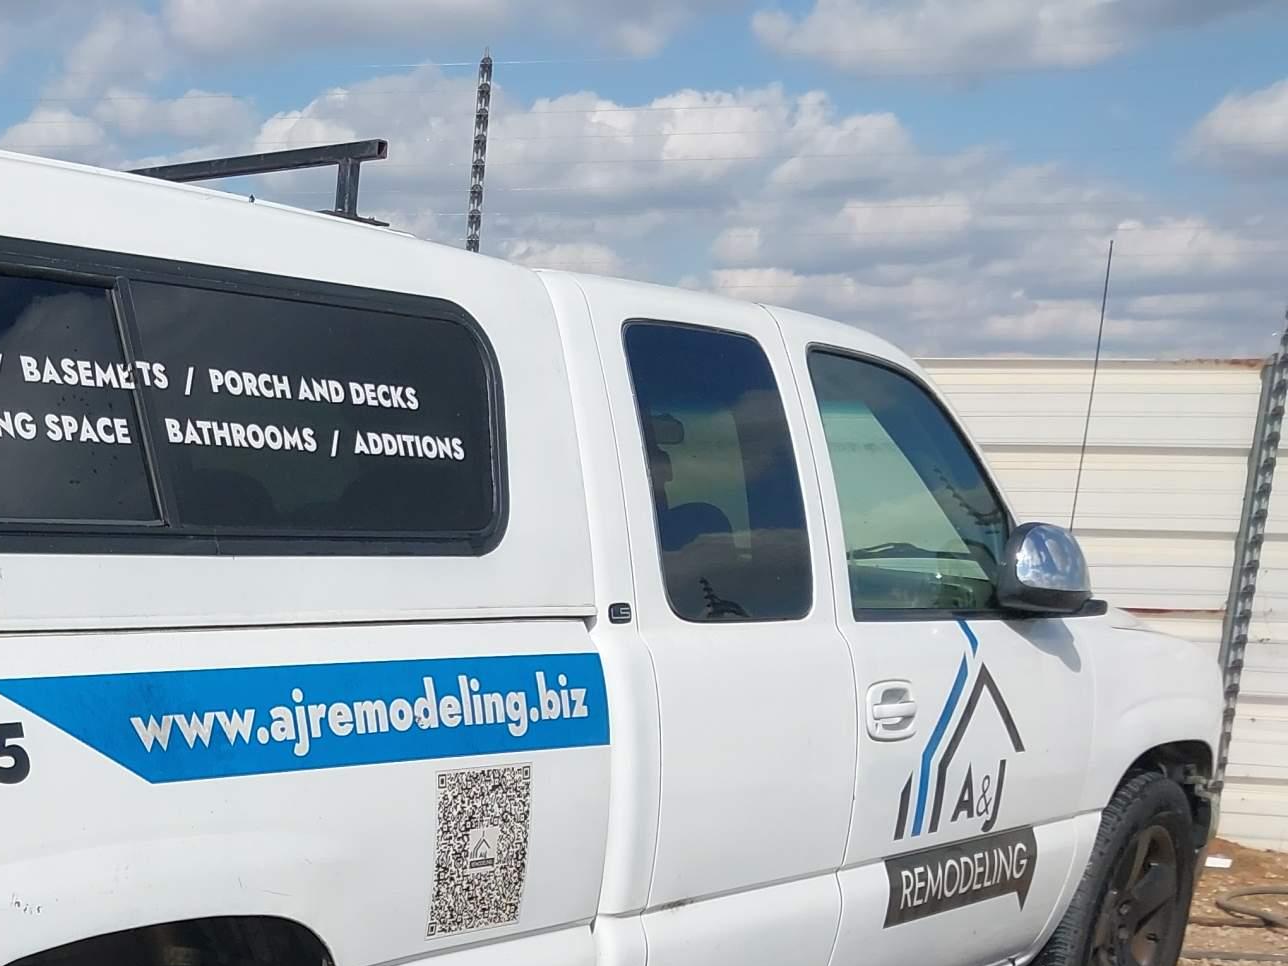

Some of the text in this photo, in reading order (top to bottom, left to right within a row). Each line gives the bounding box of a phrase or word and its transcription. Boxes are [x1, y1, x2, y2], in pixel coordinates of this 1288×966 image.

[184, 367, 194, 395] /
[209, 368, 291, 400] PORCH
[298, 376, 345, 404] AND
[349, 382, 419, 411] DECKS
[44, 413, 132, 444] SPACE
[164, 418, 317, 452] BATHROOMS
[330, 429, 339, 457] /
[354, 430, 465, 460] ADDITIONS
[610, 607, 631, 620] LS
[131, 671, 588, 757] www.ajremodeling.biz
[950, 758, 1007, 833] A&J
[899, 843, 1027, 910] REMODELING
